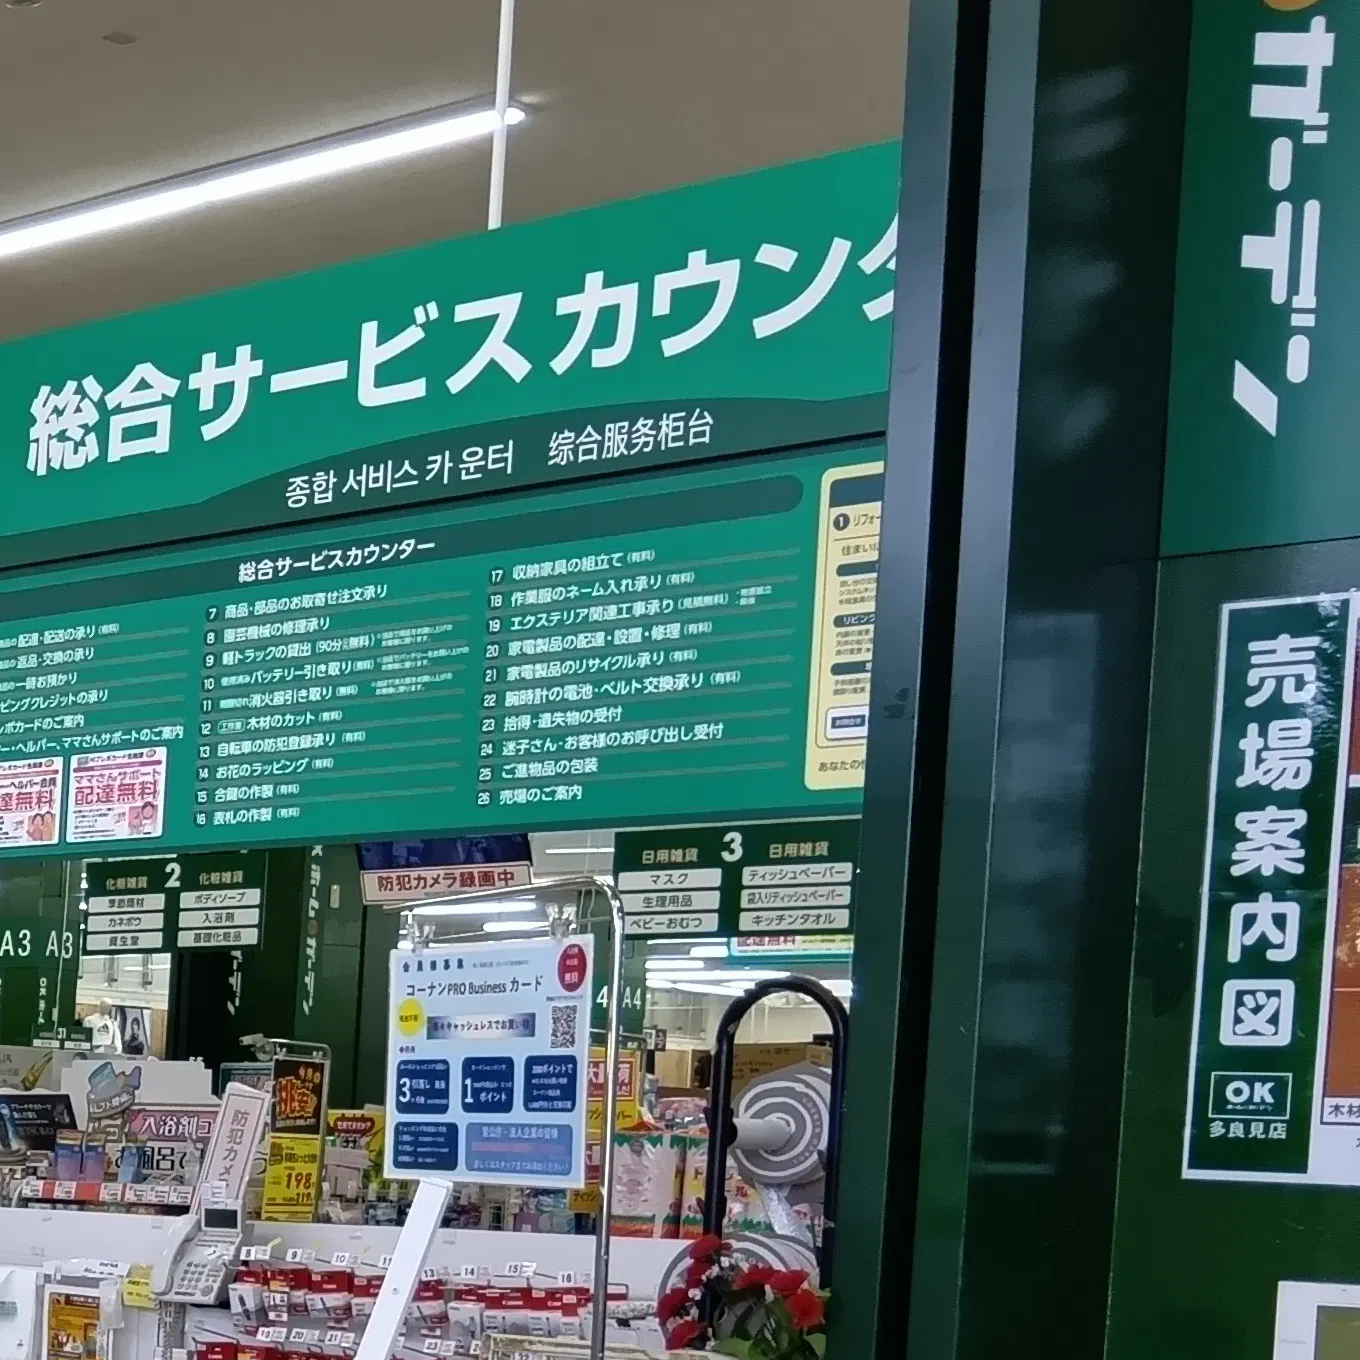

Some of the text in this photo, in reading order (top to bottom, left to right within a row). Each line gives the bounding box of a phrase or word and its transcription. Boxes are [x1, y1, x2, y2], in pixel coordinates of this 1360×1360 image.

[283, 471, 335, 511] 종합
[341, 451, 418, 501] 서비스
[547, 406, 716, 468] 综合服务柜台
[237, 537, 437, 584] 総合サービスカウンター
[512, 553, 625, 582] 収納家具の組立て
[224, 584, 388, 620] 商品・部品のお取寄せ注文承り
[510, 598, 675, 631] エクステリア関連工事承り
[222, 643, 312, 666] 軽トラックの貸出
[505, 649, 666, 682] 家電製品のリサイクル承り
[215, 757, 310, 780] お花のラッピング
[501, 757, 599, 780] ご進物品の包装
[74, 780, 160, 806] 配達無料
[499, 783, 583, 806] 売場のご案内
[641, 831, 830, 865] 日用雑貨 3 日用雑貨
[1217, 631, 1321, 1048] 売場案内図
[164, 862, 182, 888] 2
[198, 869, 244, 886] 化粧雑貨
[377, 870, 517, 893] 防犯カメラ録画中
[648, 871, 690, 886] マスク
[747, 863, 847, 883] ティッシュペーパー
[193, 891, 247, 905] ボディソープ
[642, 893, 694, 910] 生理用品
[107, 915, 142, 929] カネボウ
[201, 911, 235, 925] 入浴剤
[629, 915, 704, 931] ベビーおむつ
[751, 911, 837, 928] キッチンタオル
[45, 931, 73, 959] A3
[467, 980, 507, 995] Business
[509, 974, 544, 993] カード
[622, 989, 642, 1011] A4
[1224, 1079, 1275, 1106] OK
[1208, 1118, 1288, 1141] 多良見店
[285, 1172, 313, 1190] 198
[244, 1248, 253, 1258] 8
[289, 1250, 298, 1261] 9
[334, 1253, 347, 1264] 10
[463, 1266, 476, 1278] 14
[292, 1329, 305, 1341] 20
